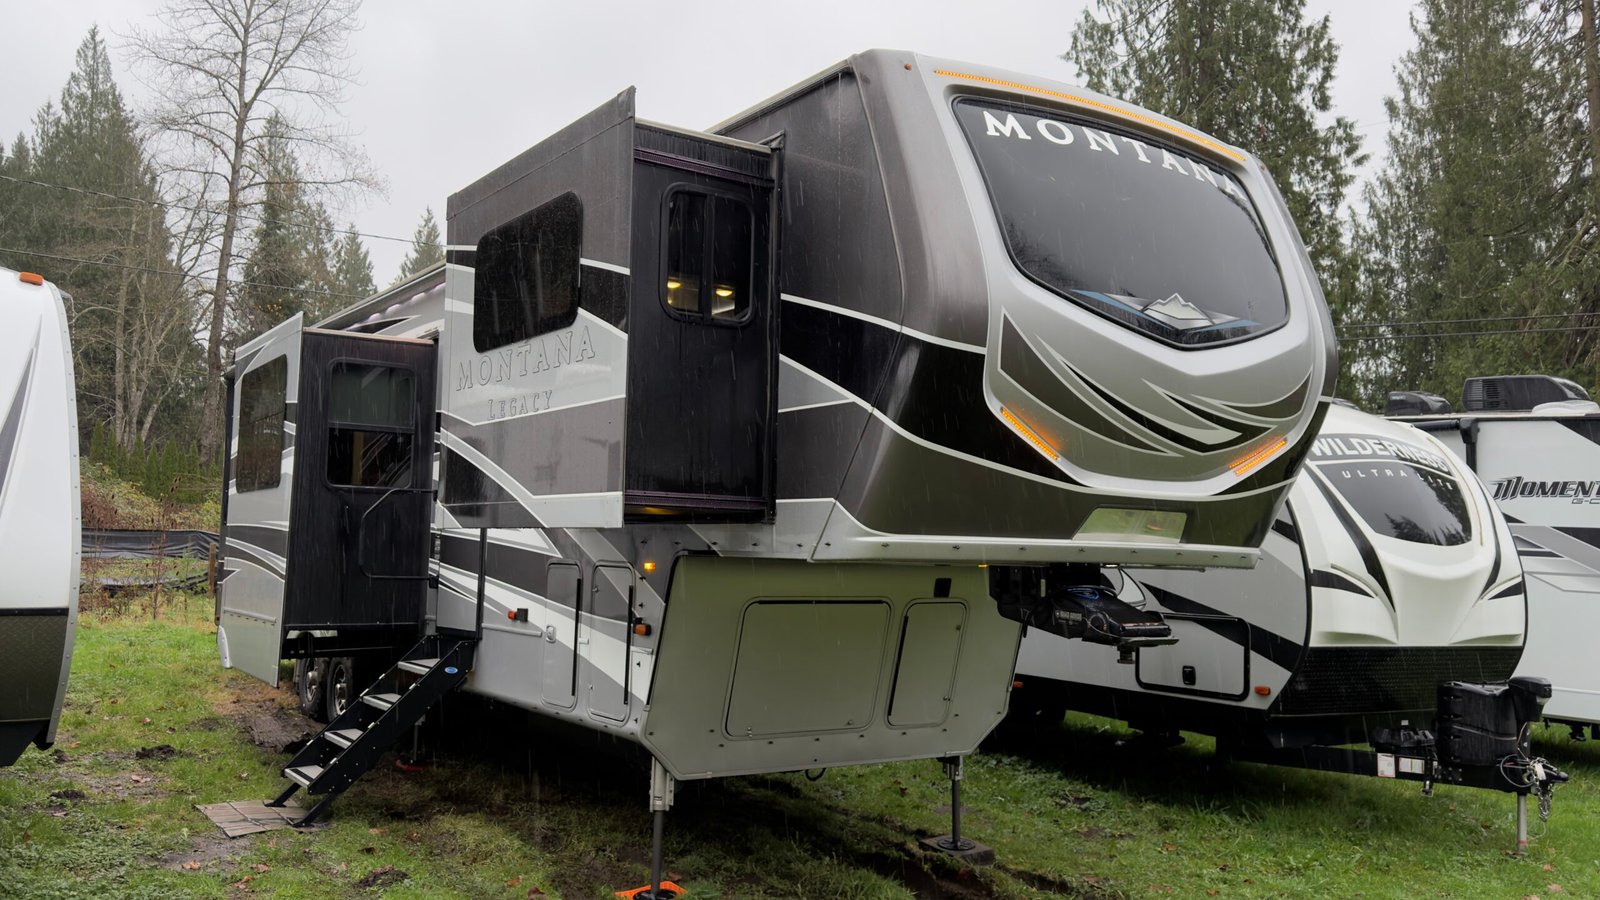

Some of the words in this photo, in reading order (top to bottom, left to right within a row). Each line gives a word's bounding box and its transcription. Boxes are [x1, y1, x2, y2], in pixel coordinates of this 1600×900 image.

[982, 111, 1247, 201] MONTANA
[455, 325, 596, 391] MONTANA
[487, 390, 553, 420] LEGACY
[1341, 469, 1408, 479] ULTRA
